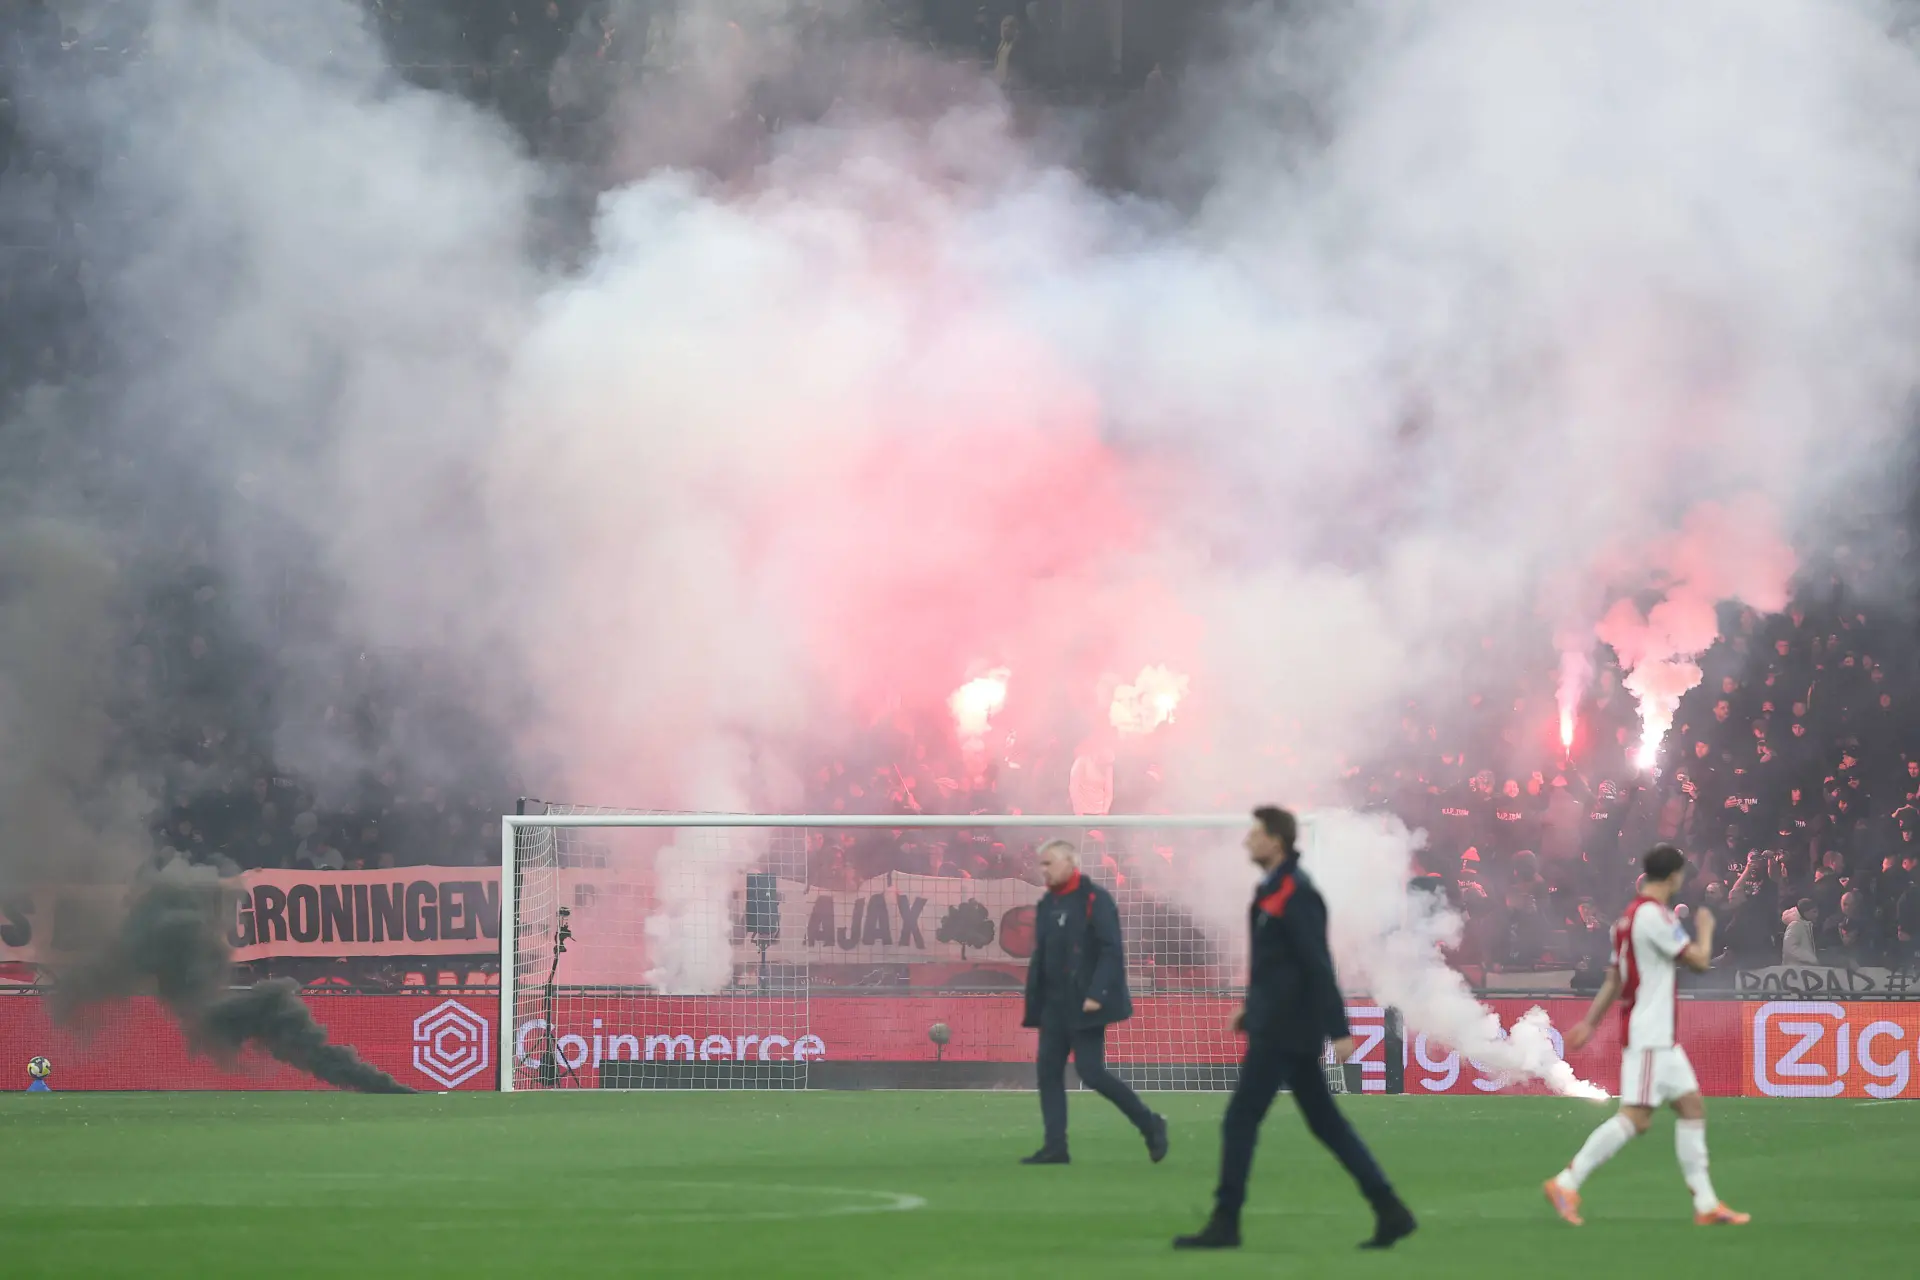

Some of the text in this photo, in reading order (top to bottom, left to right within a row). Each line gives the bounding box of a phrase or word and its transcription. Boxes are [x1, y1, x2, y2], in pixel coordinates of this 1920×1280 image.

[229, 880, 499, 948] GRONINGEN
[806, 893, 928, 951] AJAX
[516, 1018, 826, 1069] Coinmerce
[1772, 1018, 1920, 1098] Zig
